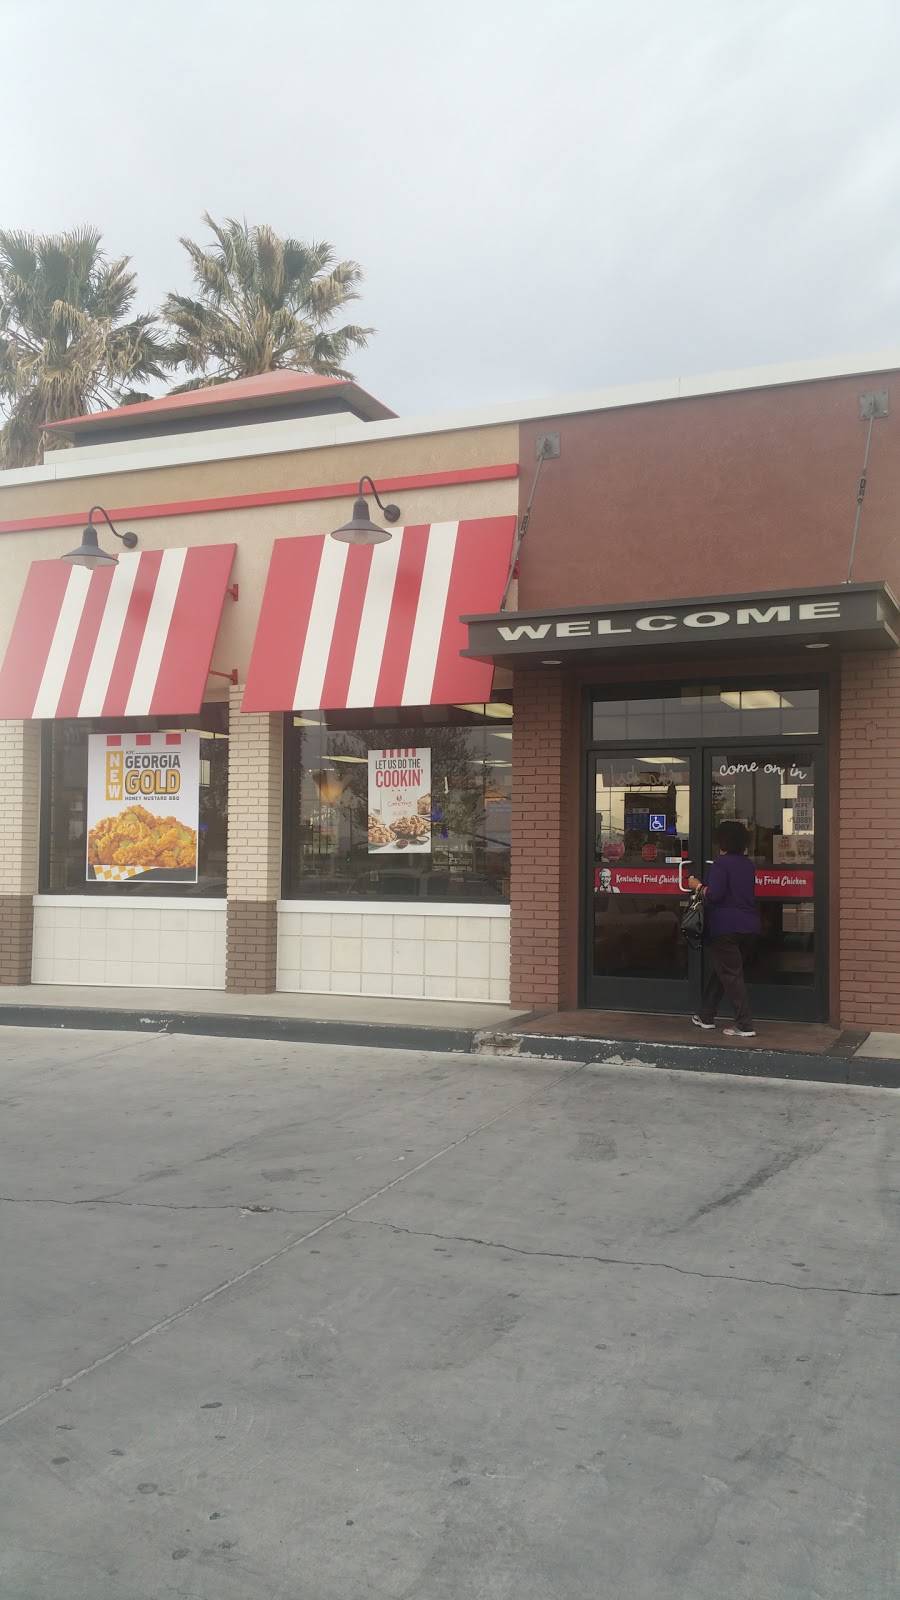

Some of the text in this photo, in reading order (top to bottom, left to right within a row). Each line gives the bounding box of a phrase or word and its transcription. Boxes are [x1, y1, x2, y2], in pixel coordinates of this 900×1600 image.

[497, 601, 841, 641] WELCOME
[125, 755, 181, 769] GEORGIA
[375, 758, 421, 770] LET US DO THE
[719, 761, 759, 776] come
[789, 763, 807, 779] in
[108, 753, 121, 799] NEW
[125, 769, 181, 795] GOLD
[375, 769, 424, 788] COOKIN'
[616, 873, 641, 884] Kentucky
[642, 874, 658, 883] Fried
[763, 875, 780, 886] Fried
[780, 875, 807, 887] Chicken
